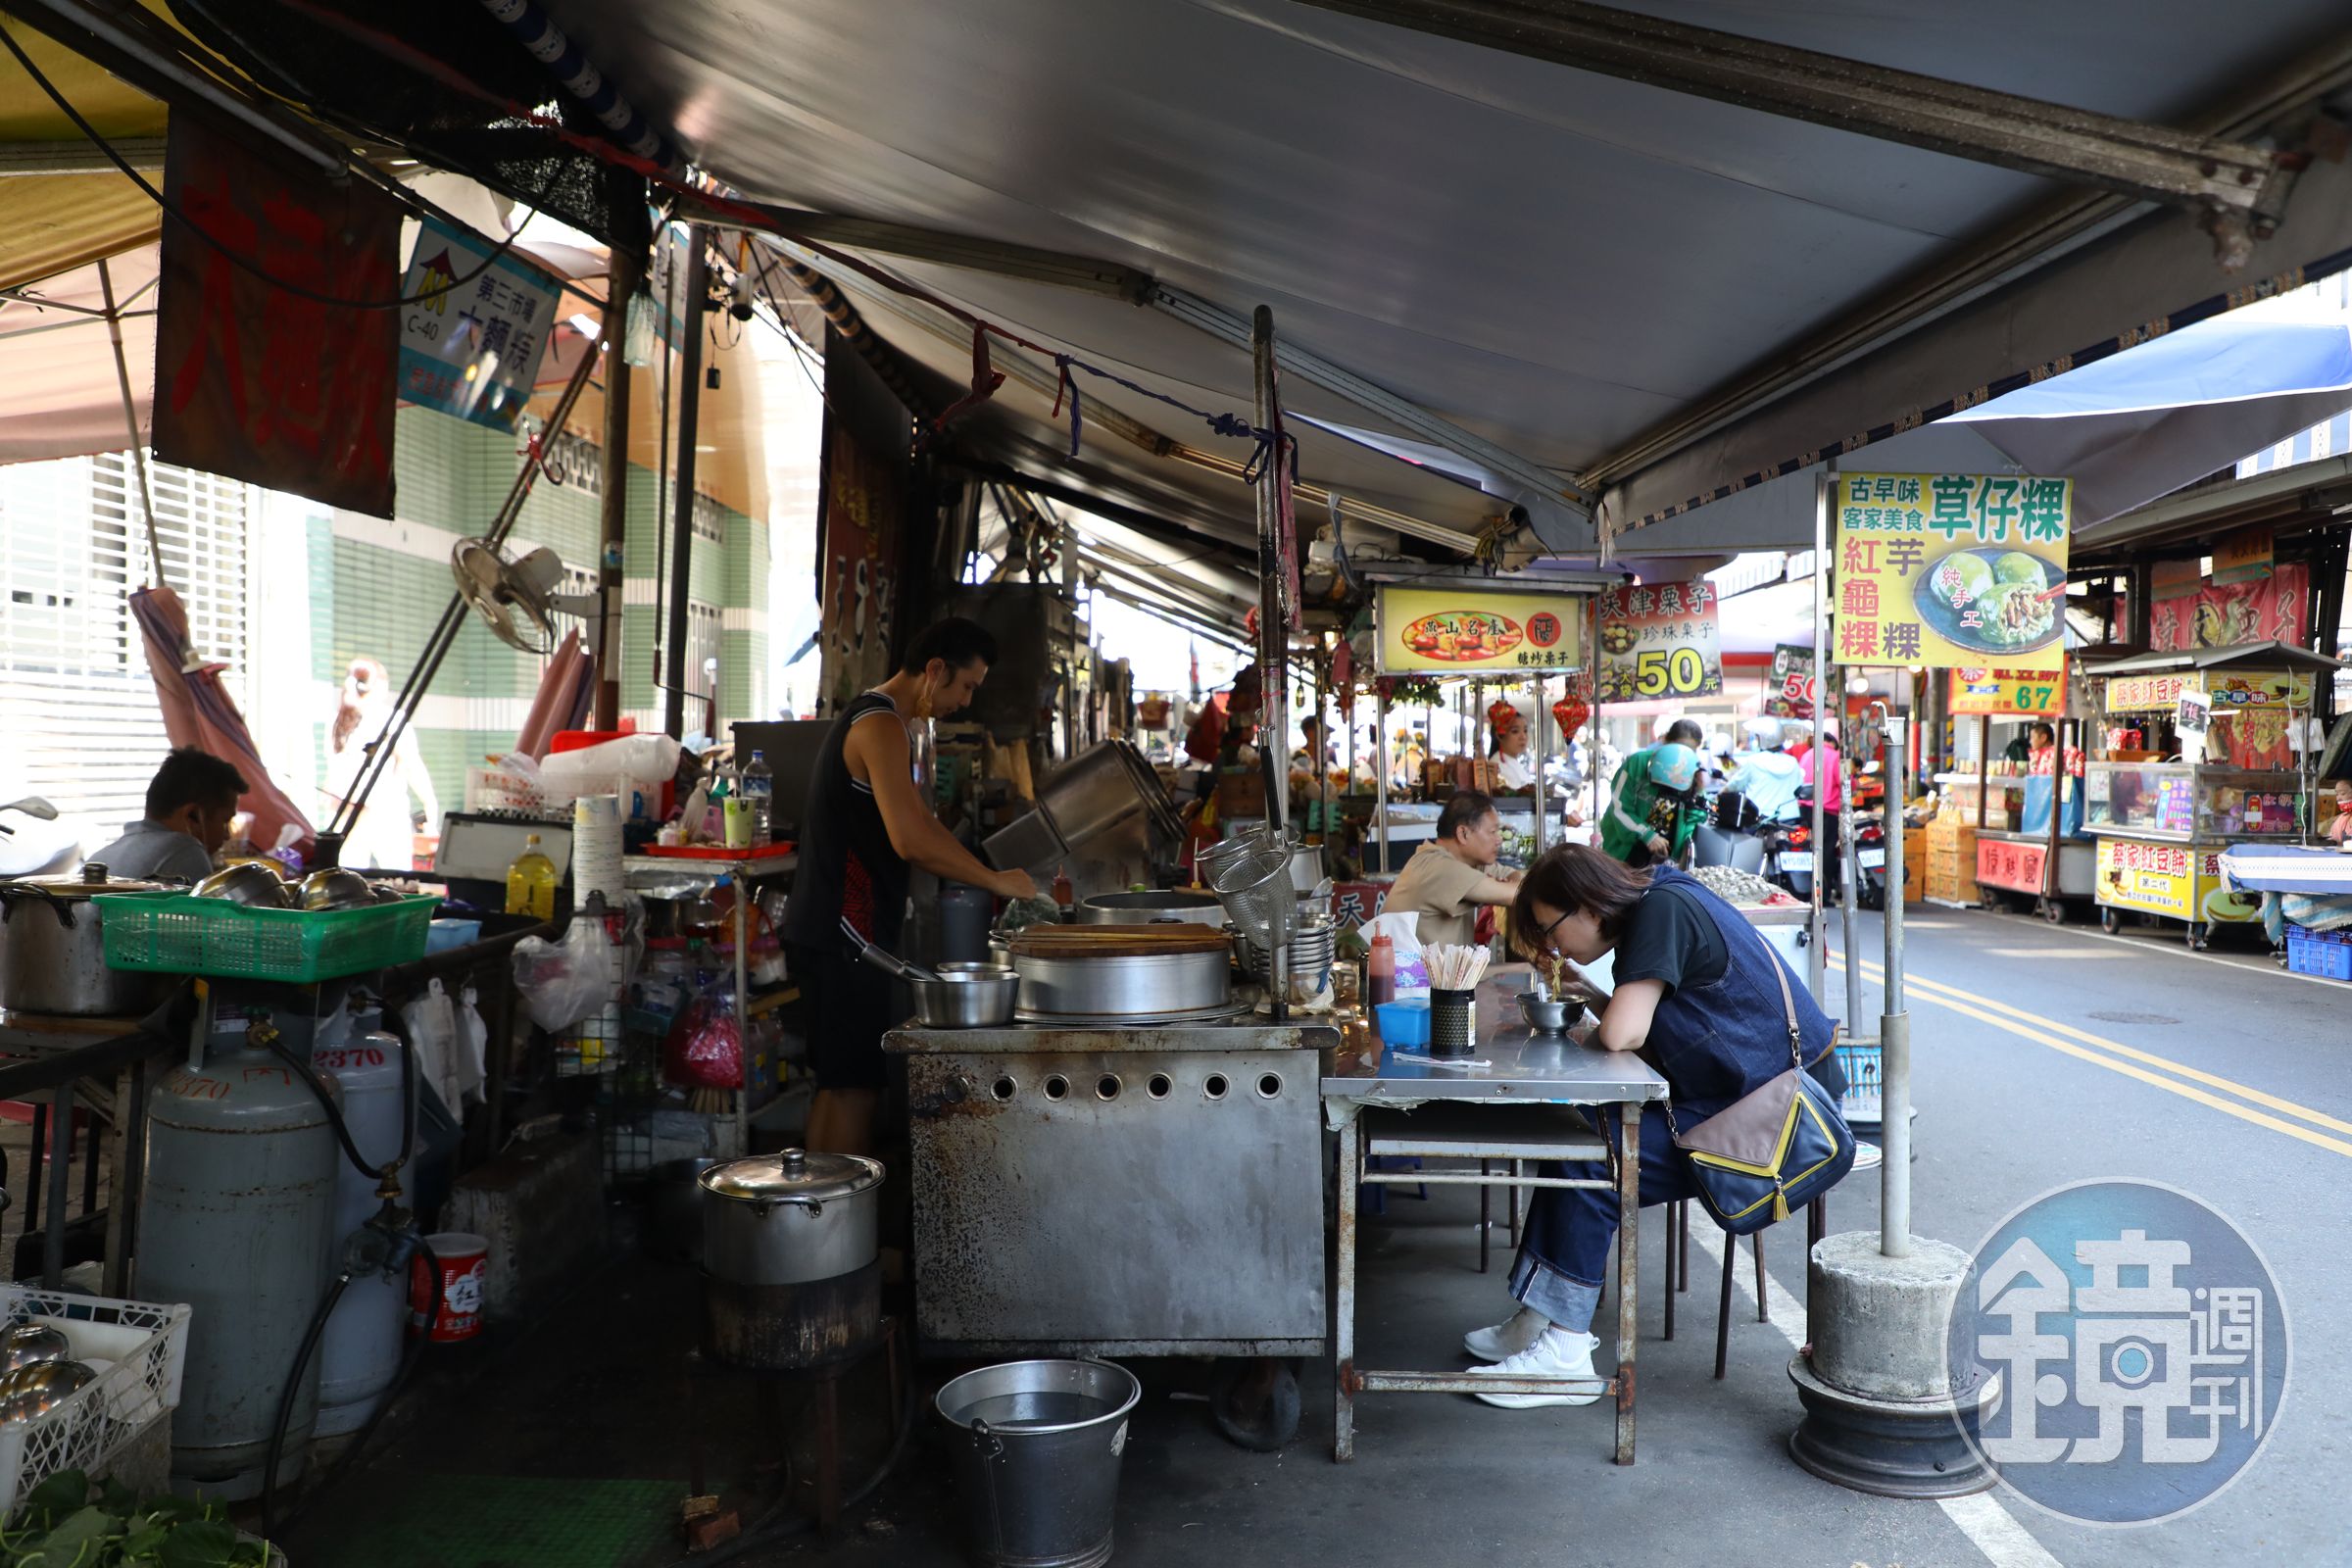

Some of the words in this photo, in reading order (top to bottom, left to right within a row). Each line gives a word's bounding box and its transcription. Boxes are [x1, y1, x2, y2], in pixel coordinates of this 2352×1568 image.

[408, 315, 438, 341] C-40
[1850, 477, 1920, 504] 古早味
[1843, 508, 1925, 531] 客家美食
[1929, 475, 2066, 542] 草仔粿
[1601, 585, 1713, 620] 天津栗子
[1940, 566, 1984, 628] 純手工
[1425, 618, 1506, 637] 燕山名產
[1642, 622, 1714, 643] 珍珠栗子
[2212, 690, 2270, 705] 古早味
[2113, 843, 2187, 879] 蔡家紅豆餅
[2142, 876, 2169, 892] 第二代
